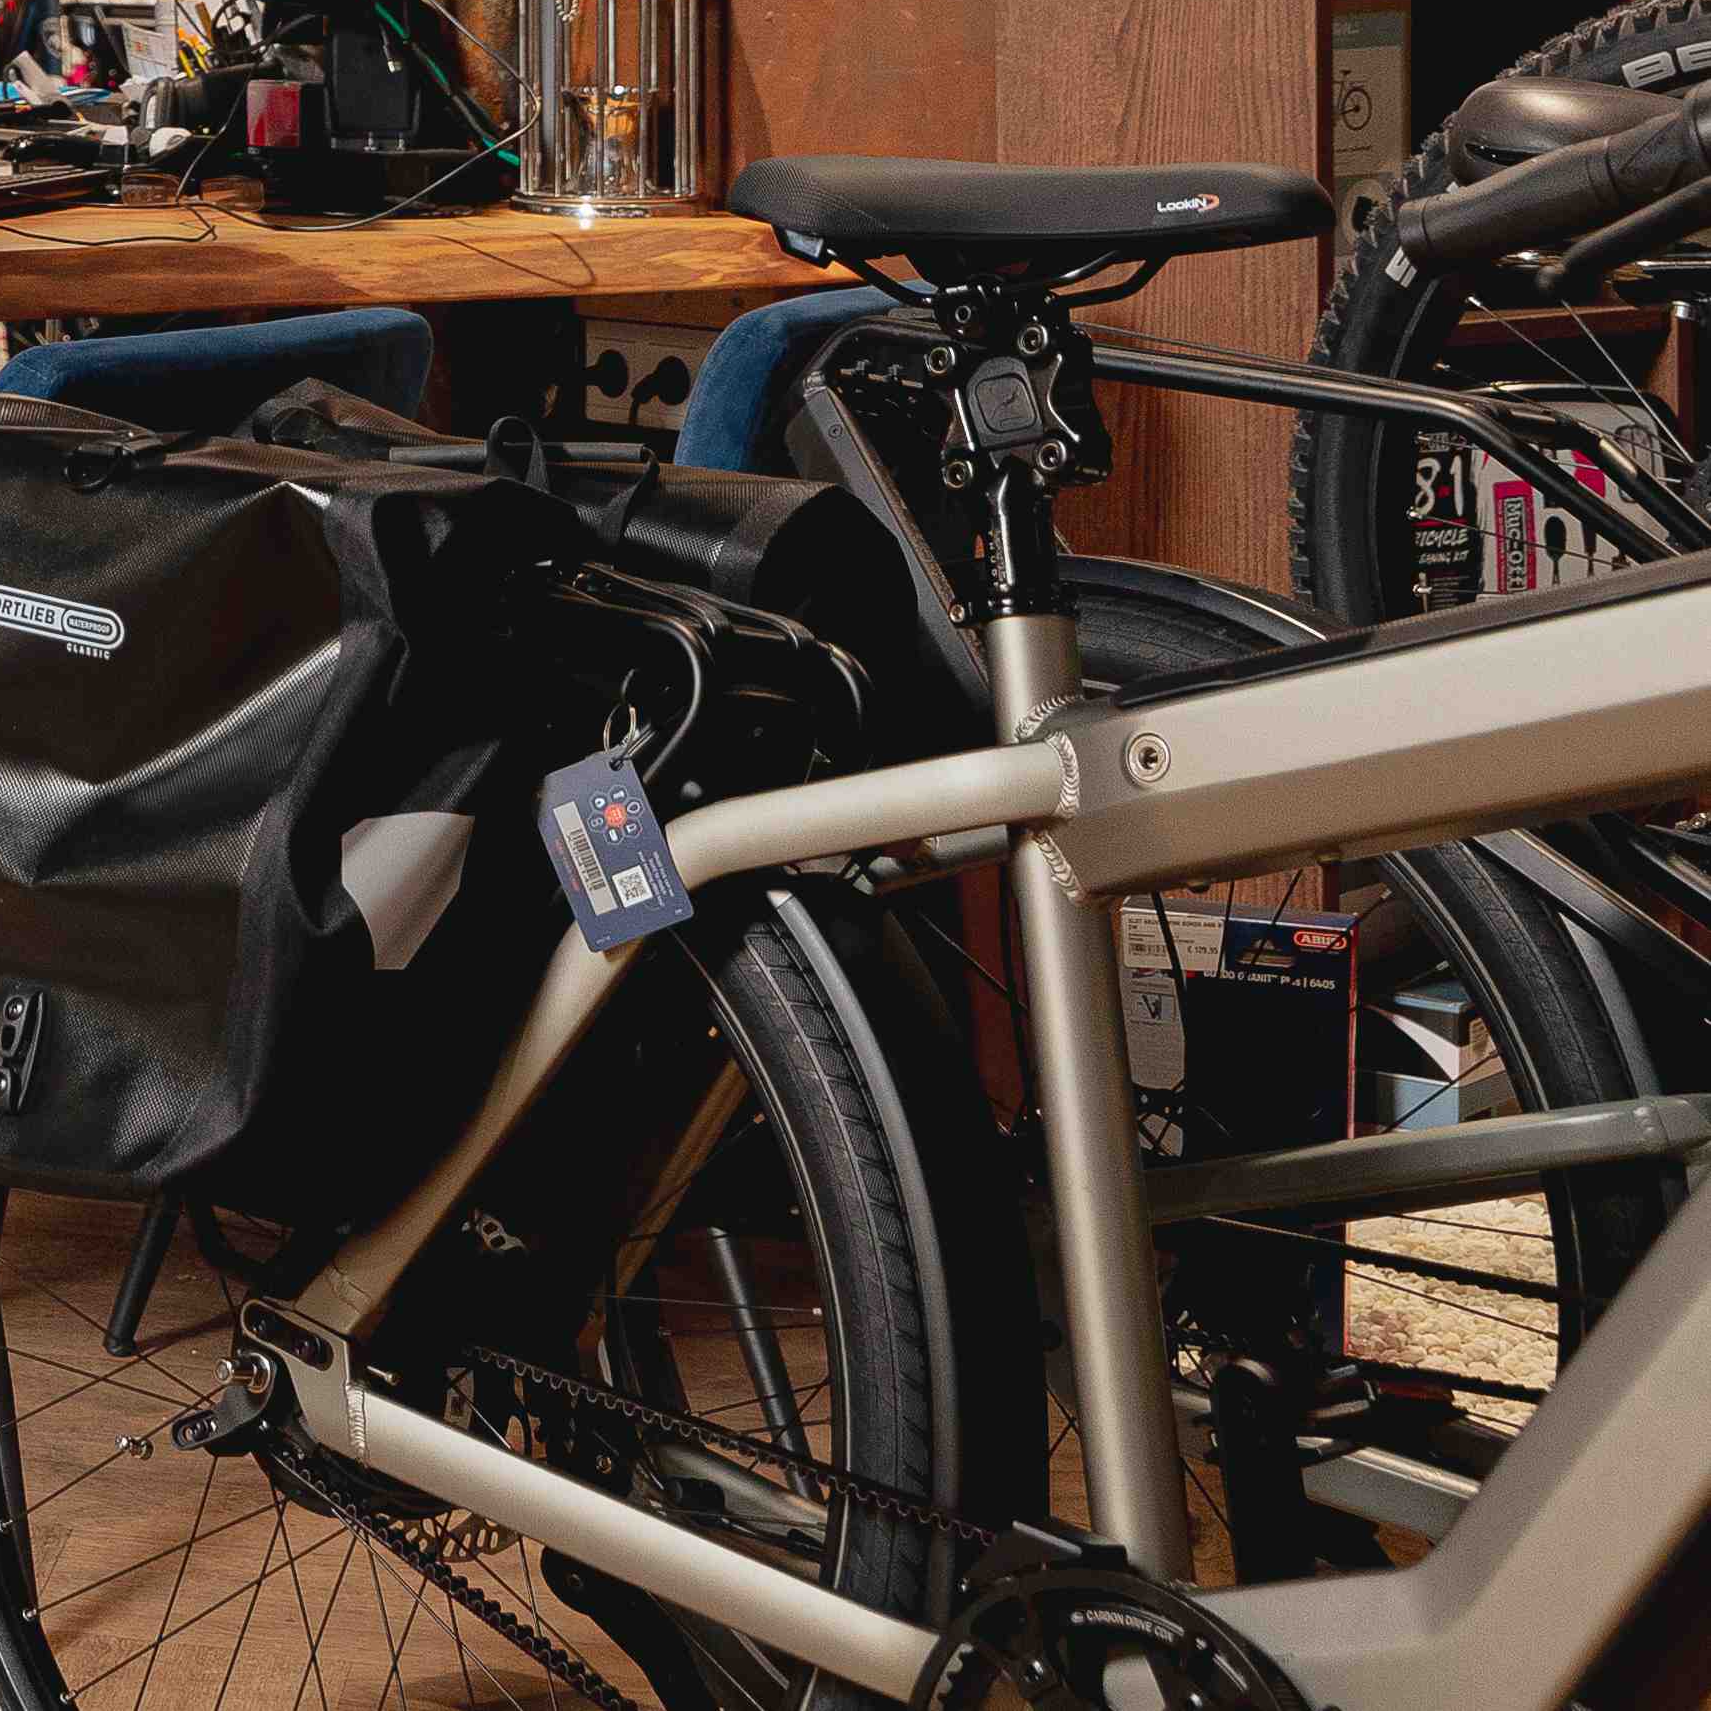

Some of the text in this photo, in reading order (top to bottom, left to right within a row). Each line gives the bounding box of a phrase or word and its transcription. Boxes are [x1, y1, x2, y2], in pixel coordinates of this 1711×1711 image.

[1505, 499, 1526, 590] Muc-Off
[68, 616, 111, 634] WATERPROOF
[66, 642, 111, 661] CLASSIC
